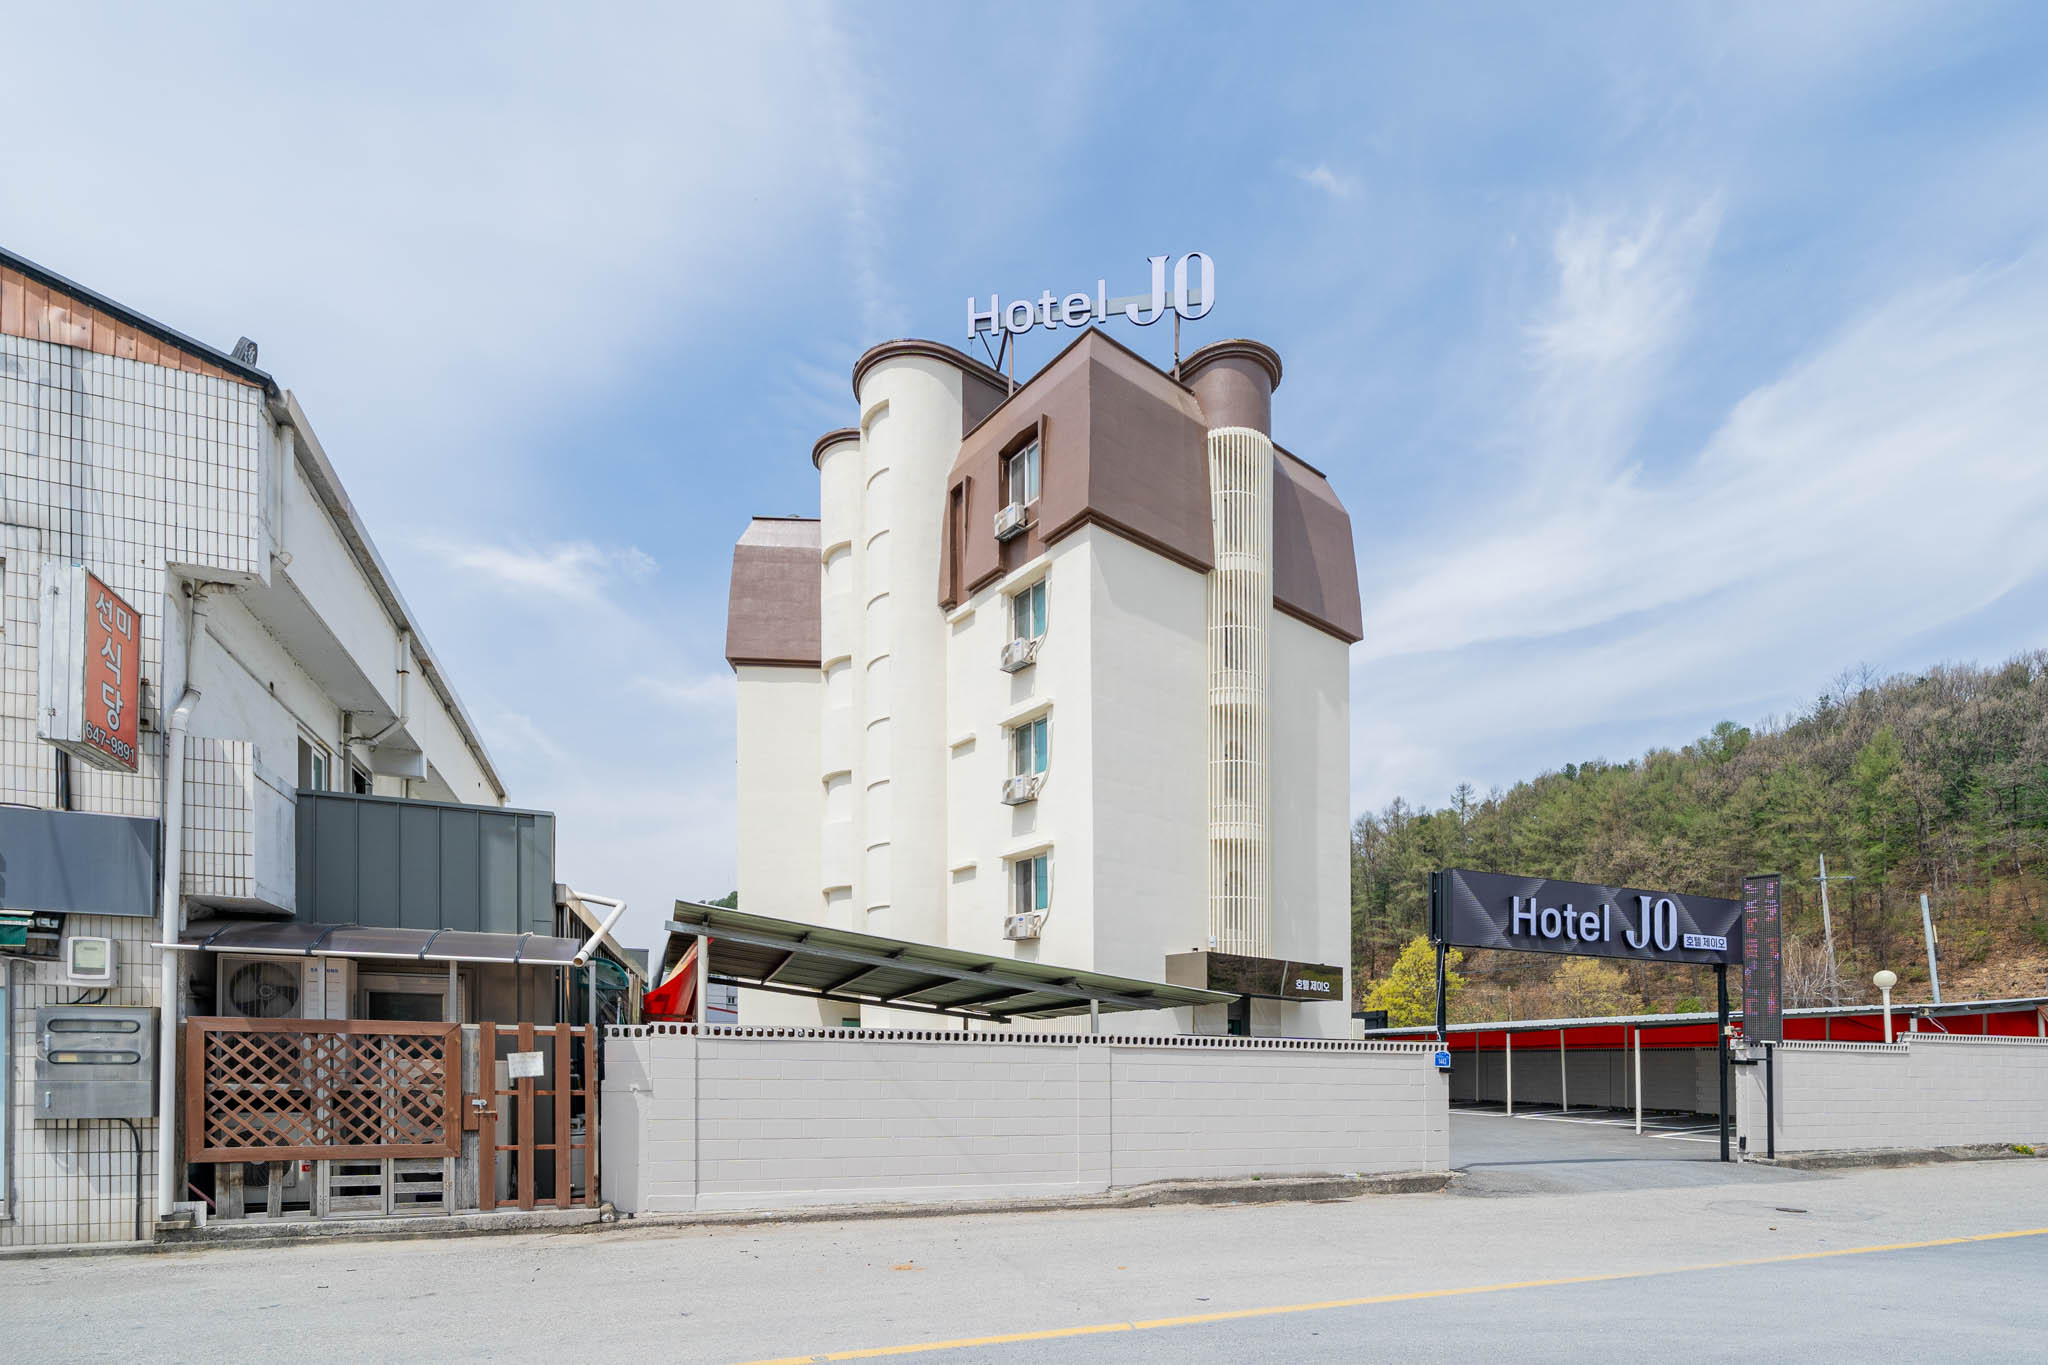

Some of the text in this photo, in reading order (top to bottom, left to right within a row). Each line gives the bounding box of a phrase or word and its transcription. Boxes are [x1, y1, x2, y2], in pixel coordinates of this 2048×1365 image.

[968, 251, 1215, 339] Hotel JO
[86, 720, 135, 764] 647-9891
[1512, 895, 1678, 951] Hotel JO
[1686, 935, 1726, 949] 호텔 제이오
[1295, 979, 1309, 990] 호텔
